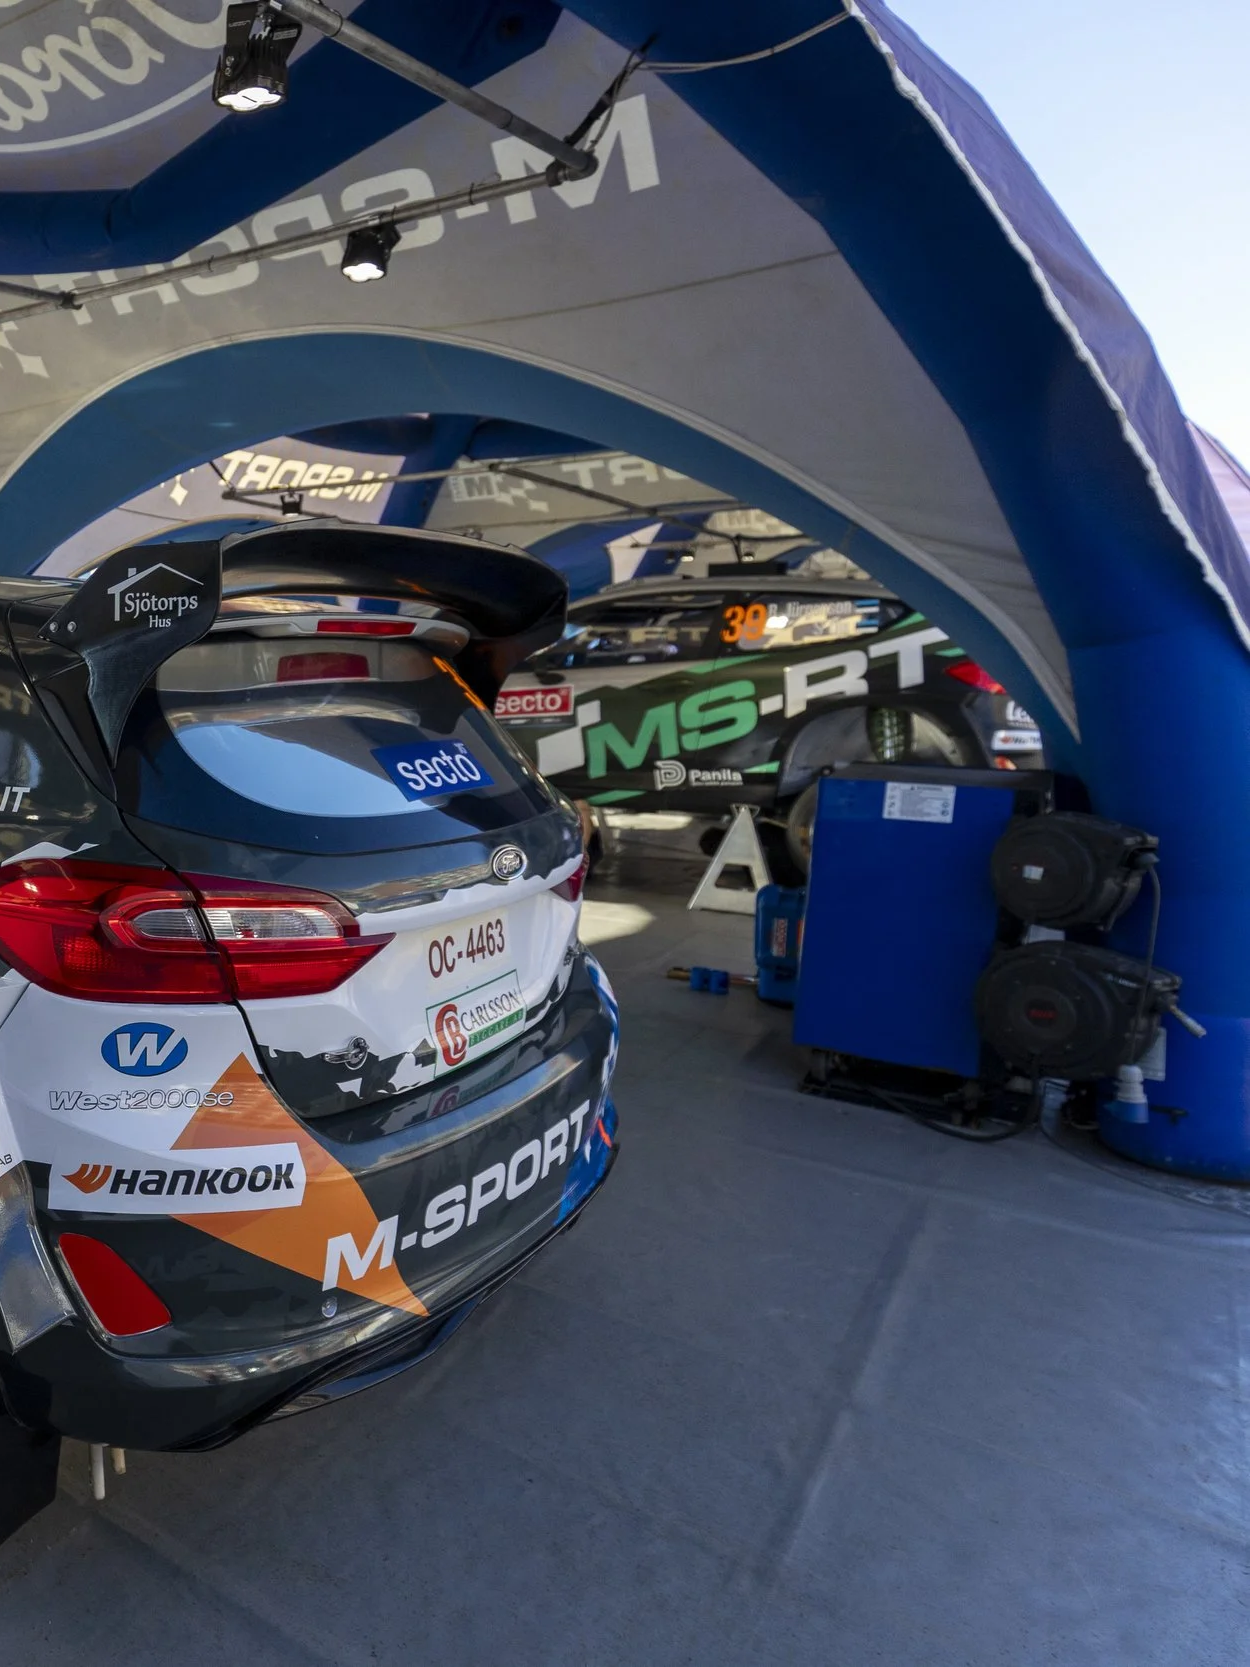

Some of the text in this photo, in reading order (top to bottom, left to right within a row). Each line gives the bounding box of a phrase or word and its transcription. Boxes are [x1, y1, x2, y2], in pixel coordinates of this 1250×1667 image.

[124, 592, 199, 619] Sjötorps
[148, 615, 171, 628] Hus
[720, 602, 767, 643] 39
[494, 691, 562, 714] secto
[586, 627, 953, 779] MS-RT
[396, 749, 482, 791] secto
[689, 769, 743, 782] Panila
[502, 850, 522, 874] Ford
[428, 917, 506, 979] OC-4463
[460, 988, 521, 1033] CARLSSON
[49, 1088, 235, 1111] West2000.se
[322, 1100, 591, 1292] M-SPORT
